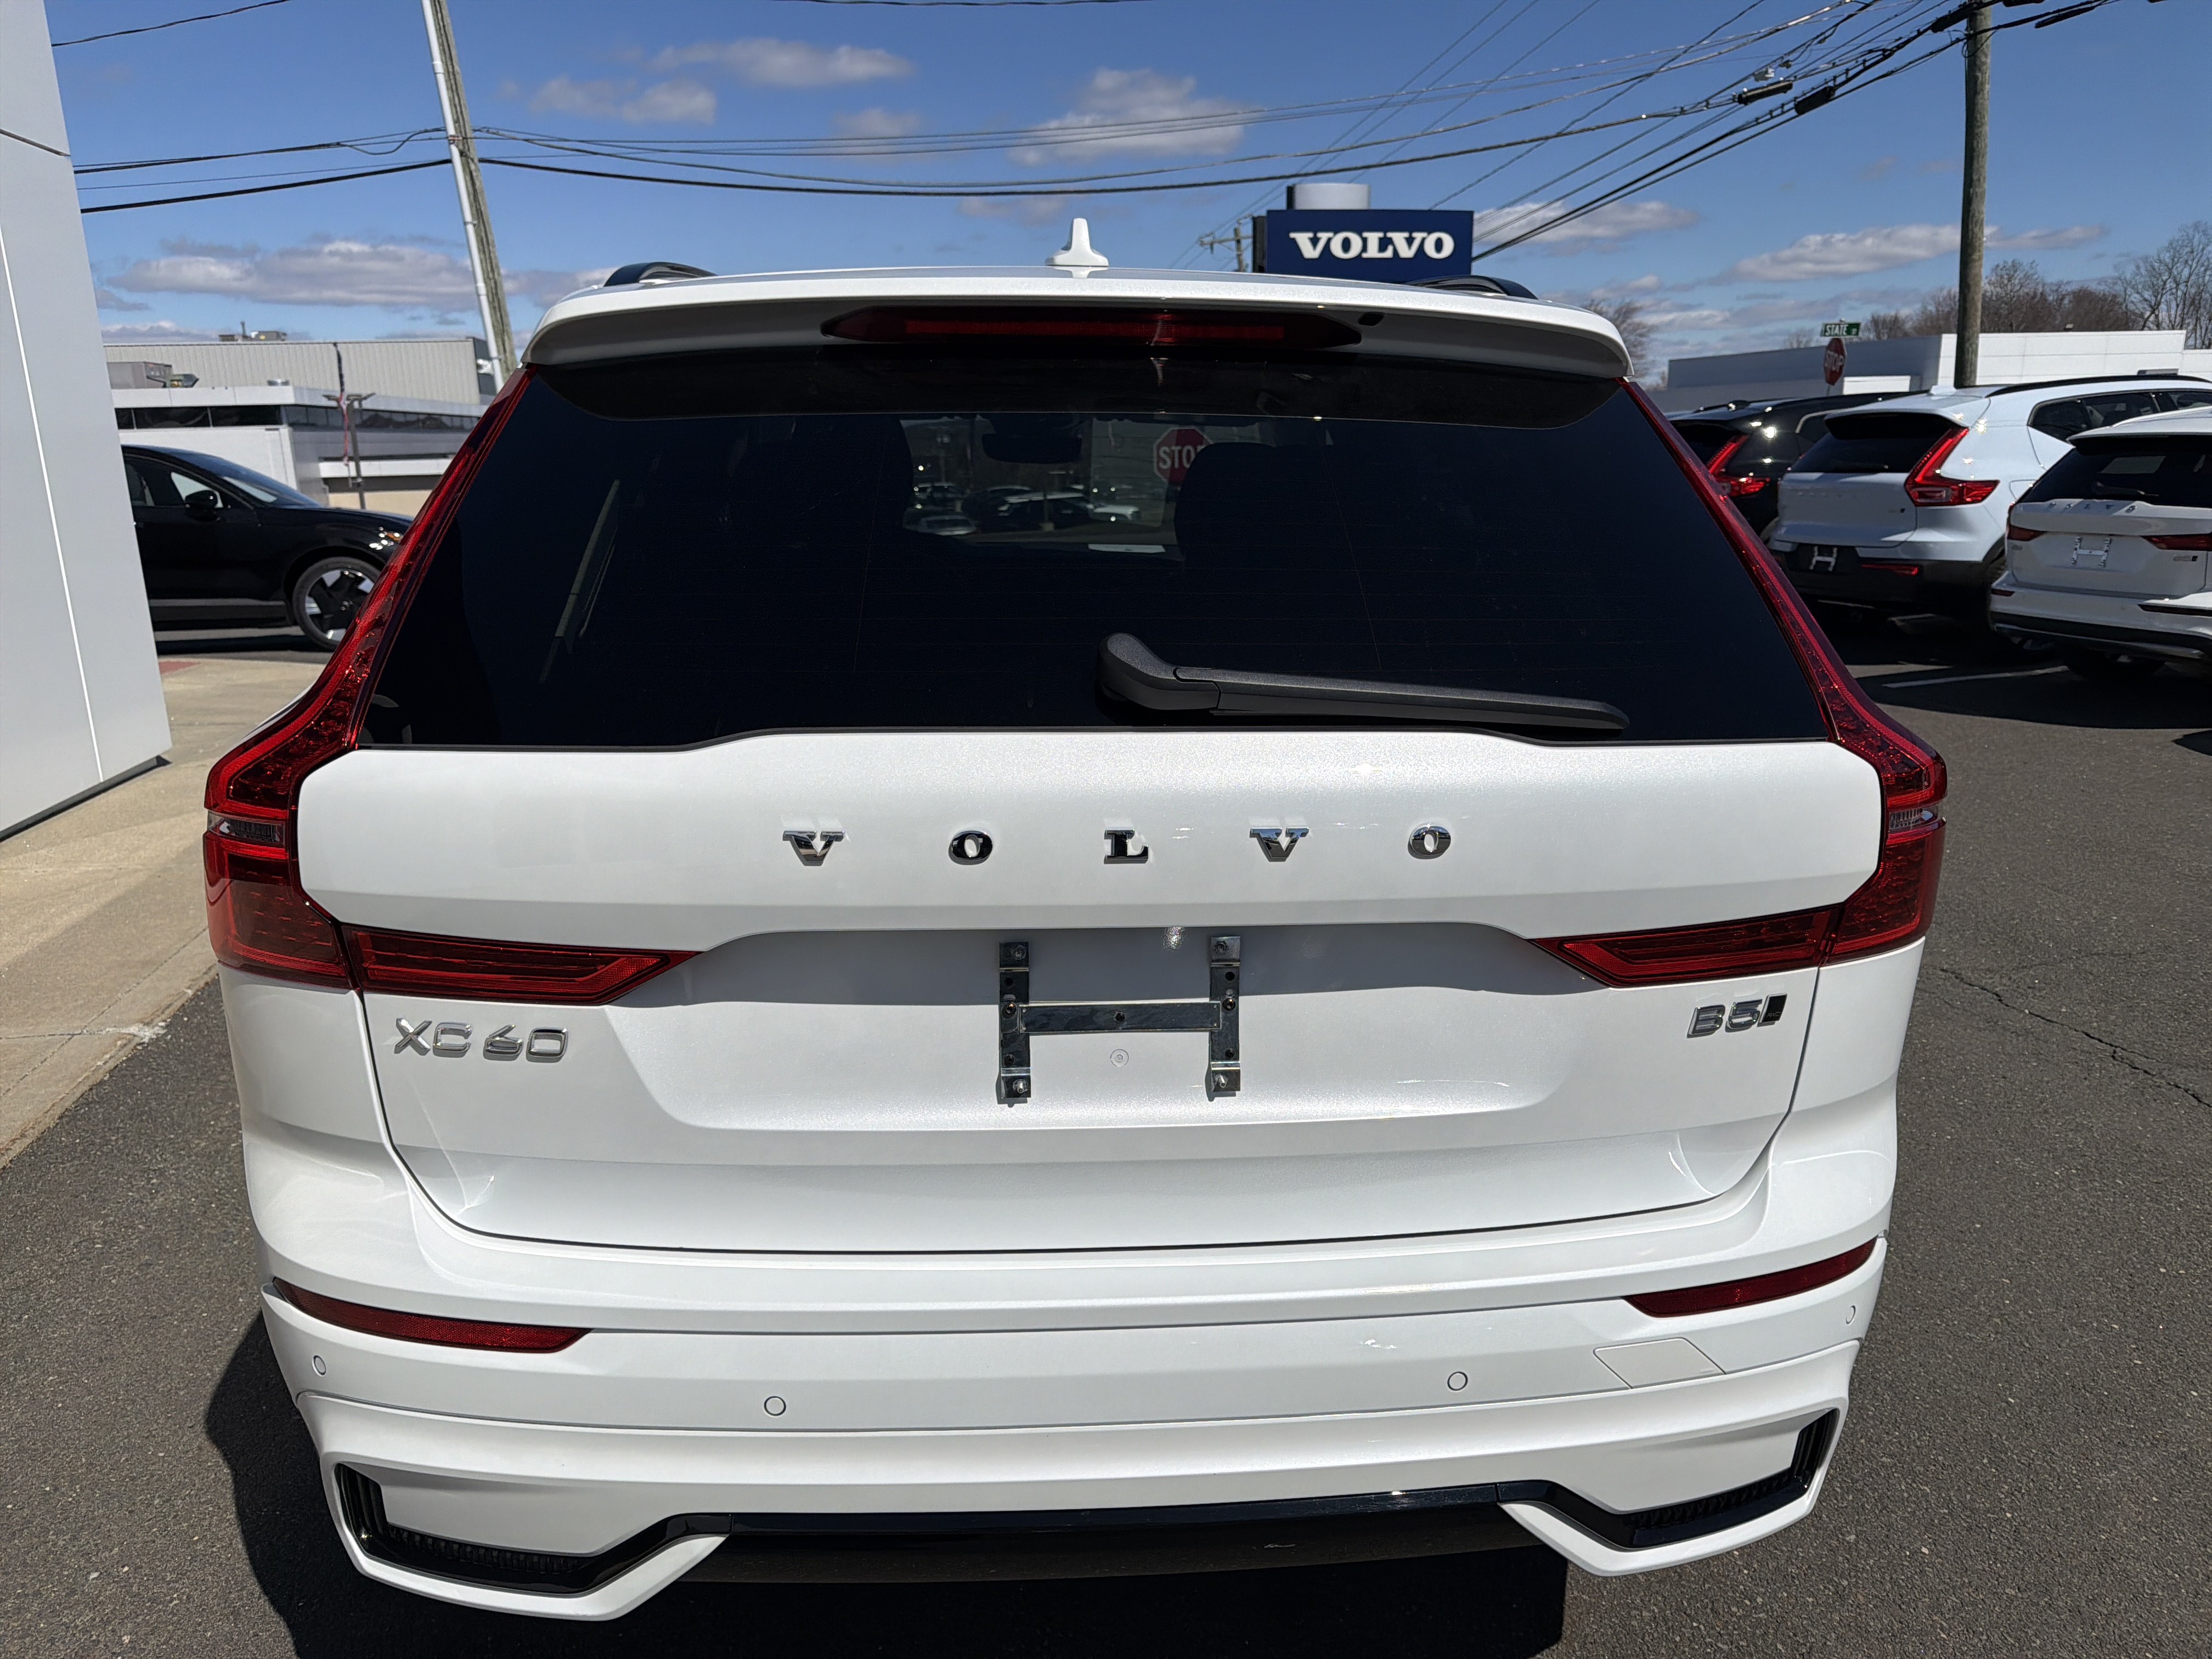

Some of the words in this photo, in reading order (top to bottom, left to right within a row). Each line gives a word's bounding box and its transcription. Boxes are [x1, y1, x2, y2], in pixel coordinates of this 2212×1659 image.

[1289, 232, 1455, 259] VOLVO
[1825, 324, 1848, 336] STATE
[1824, 349, 1844, 373] STOP
[1158, 444, 1205, 470] STO
[782, 824, 1452, 867] VOLVO
[1687, 998, 1763, 1037] B5
